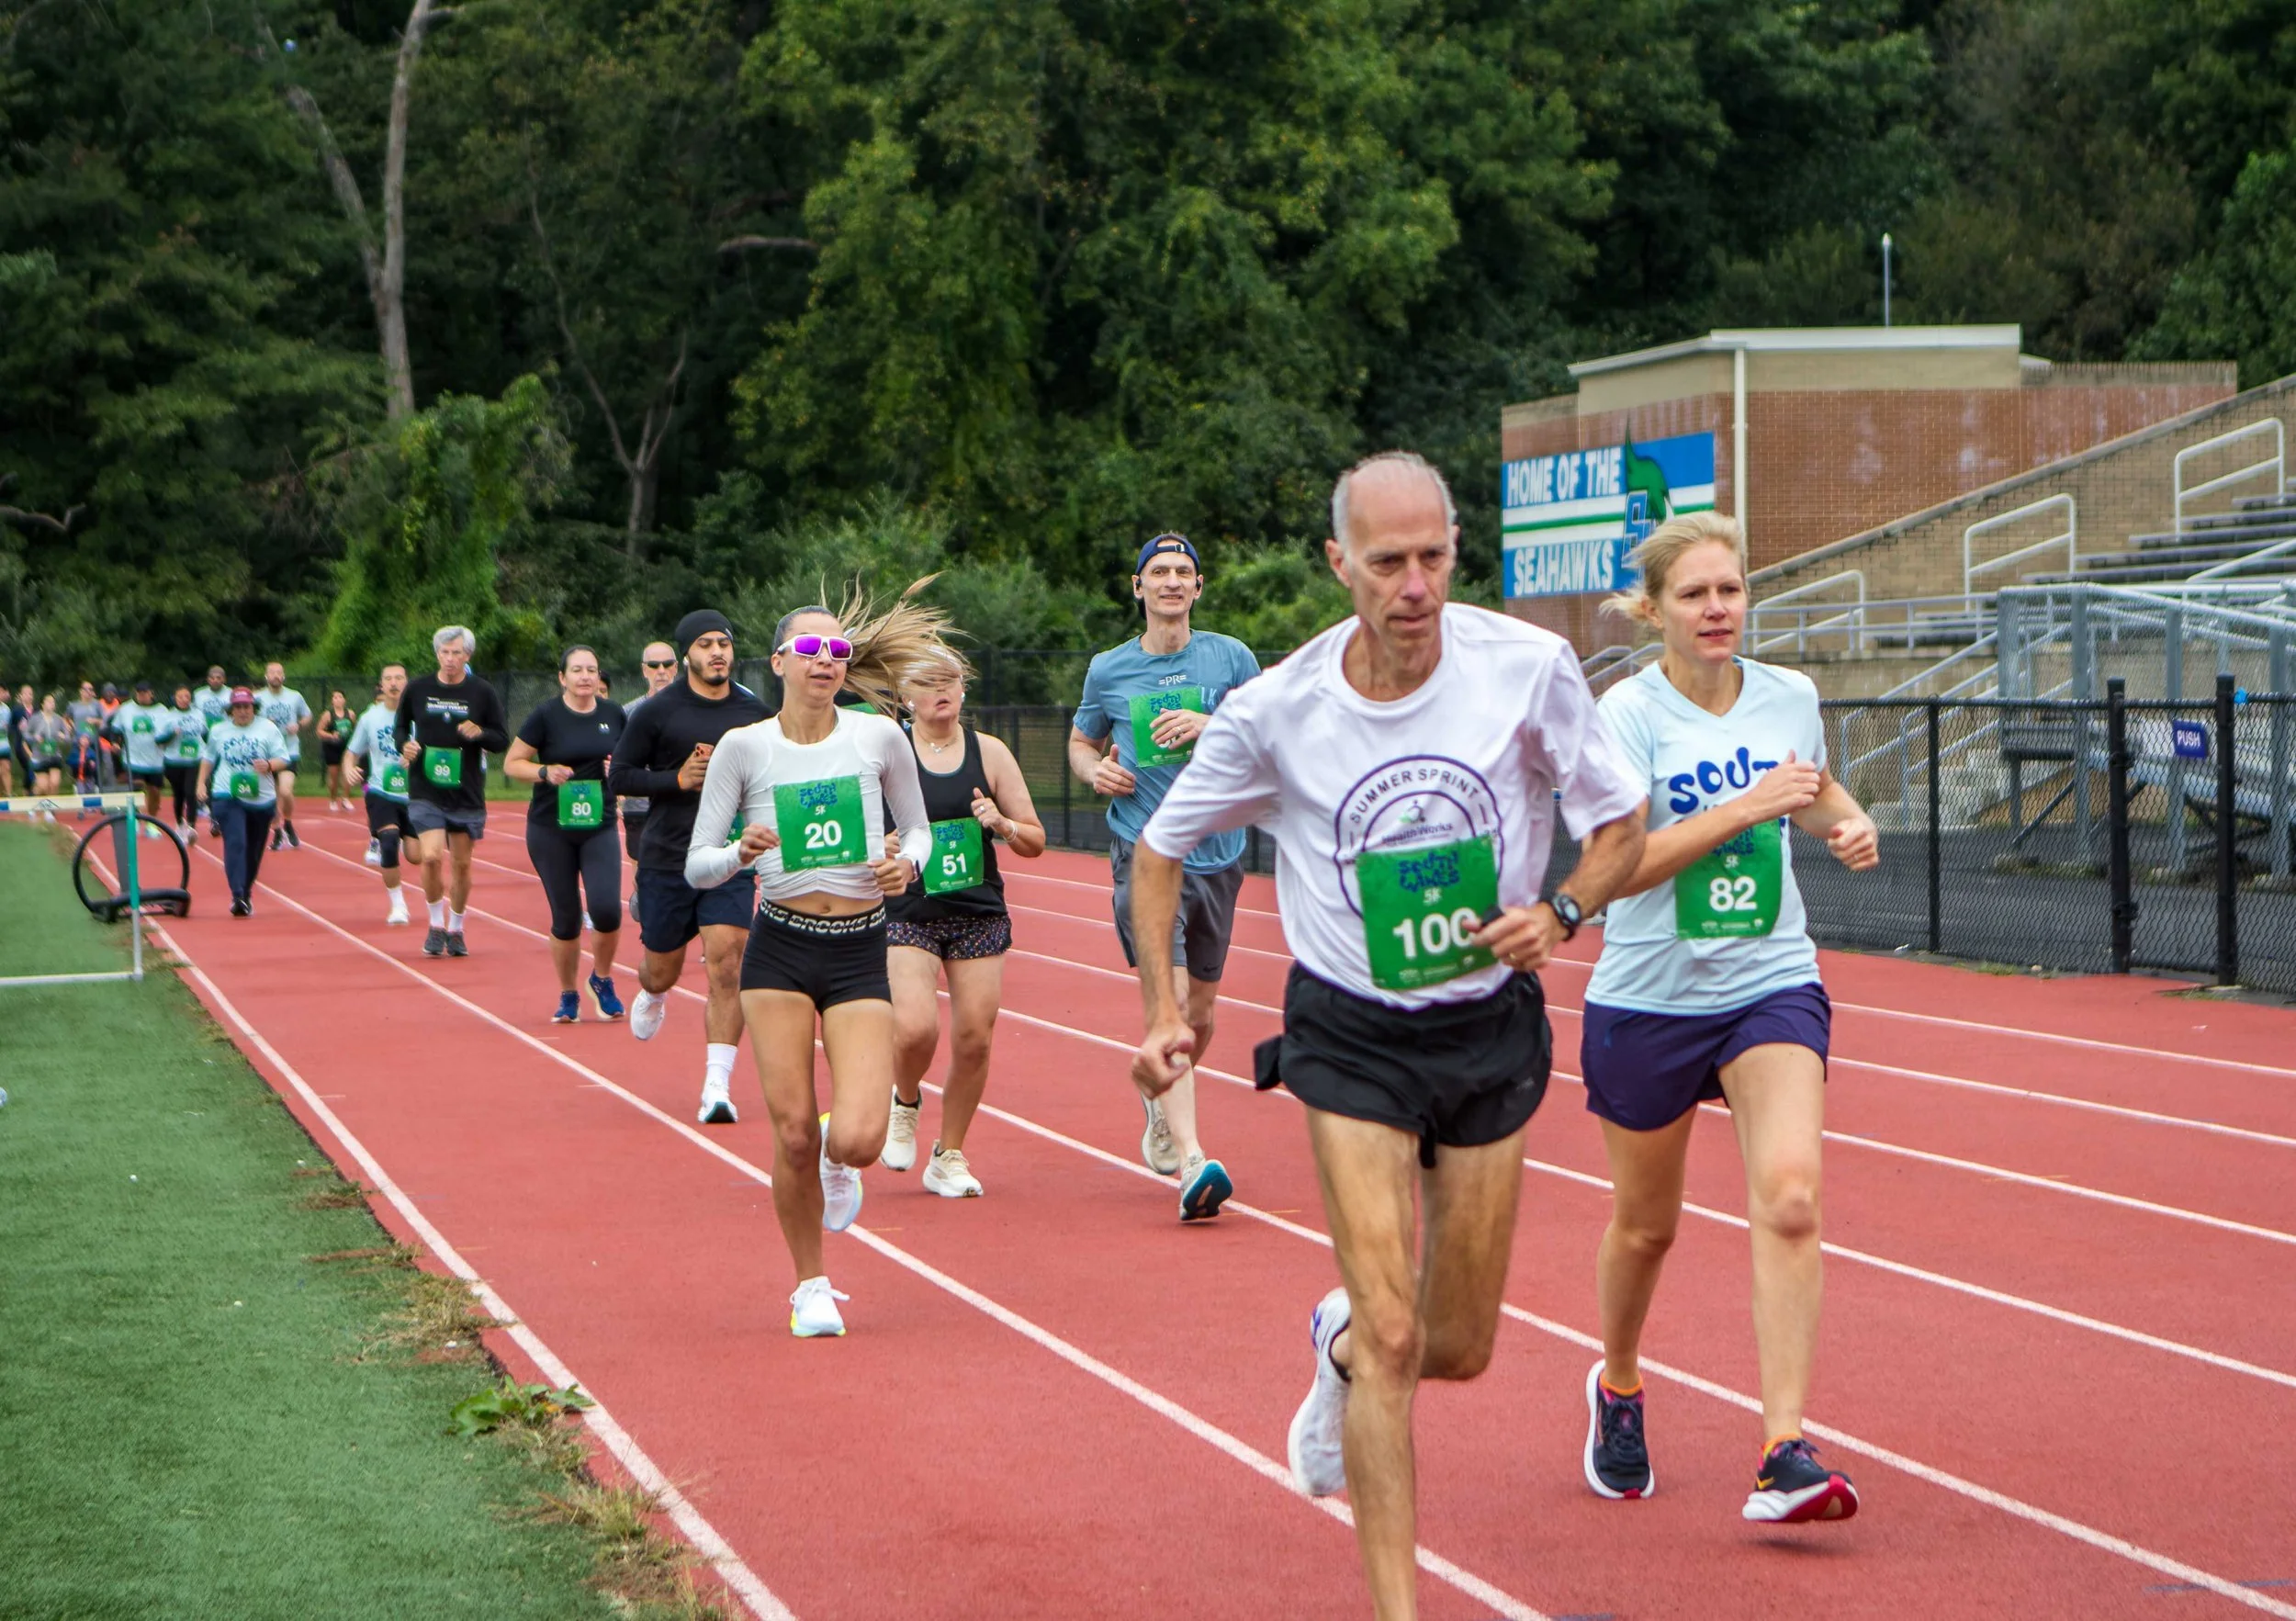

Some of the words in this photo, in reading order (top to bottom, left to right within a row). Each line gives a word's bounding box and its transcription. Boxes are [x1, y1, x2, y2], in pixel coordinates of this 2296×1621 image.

[1507, 456, 1553, 506] HOME
[1557, 452, 1581, 500] OF
[1585, 446, 1622, 497] THE
[1514, 539, 1614, 595] SEAHAWKS
[2177, 730, 2201, 748] PUSH
[433, 764, 451, 776] 99
[1669, 747, 1780, 815] SOUT
[800, 782, 837, 796] SOUTH
[1349, 770, 1412, 824] SUMMER
[1418, 768, 1479, 799] SPRINT
[572, 802, 591, 816] 80
[815, 805, 827, 816] 5K
[805, 819, 842, 850] 20
[942, 852, 967, 875] 51
[1724, 855, 1740, 869] 5K
[1424, 887, 1442, 906] 5K
[1709, 875, 1758, 912] 82
[788, 913, 868, 934] BROOKS
[1392, 906, 1479, 960] 100
